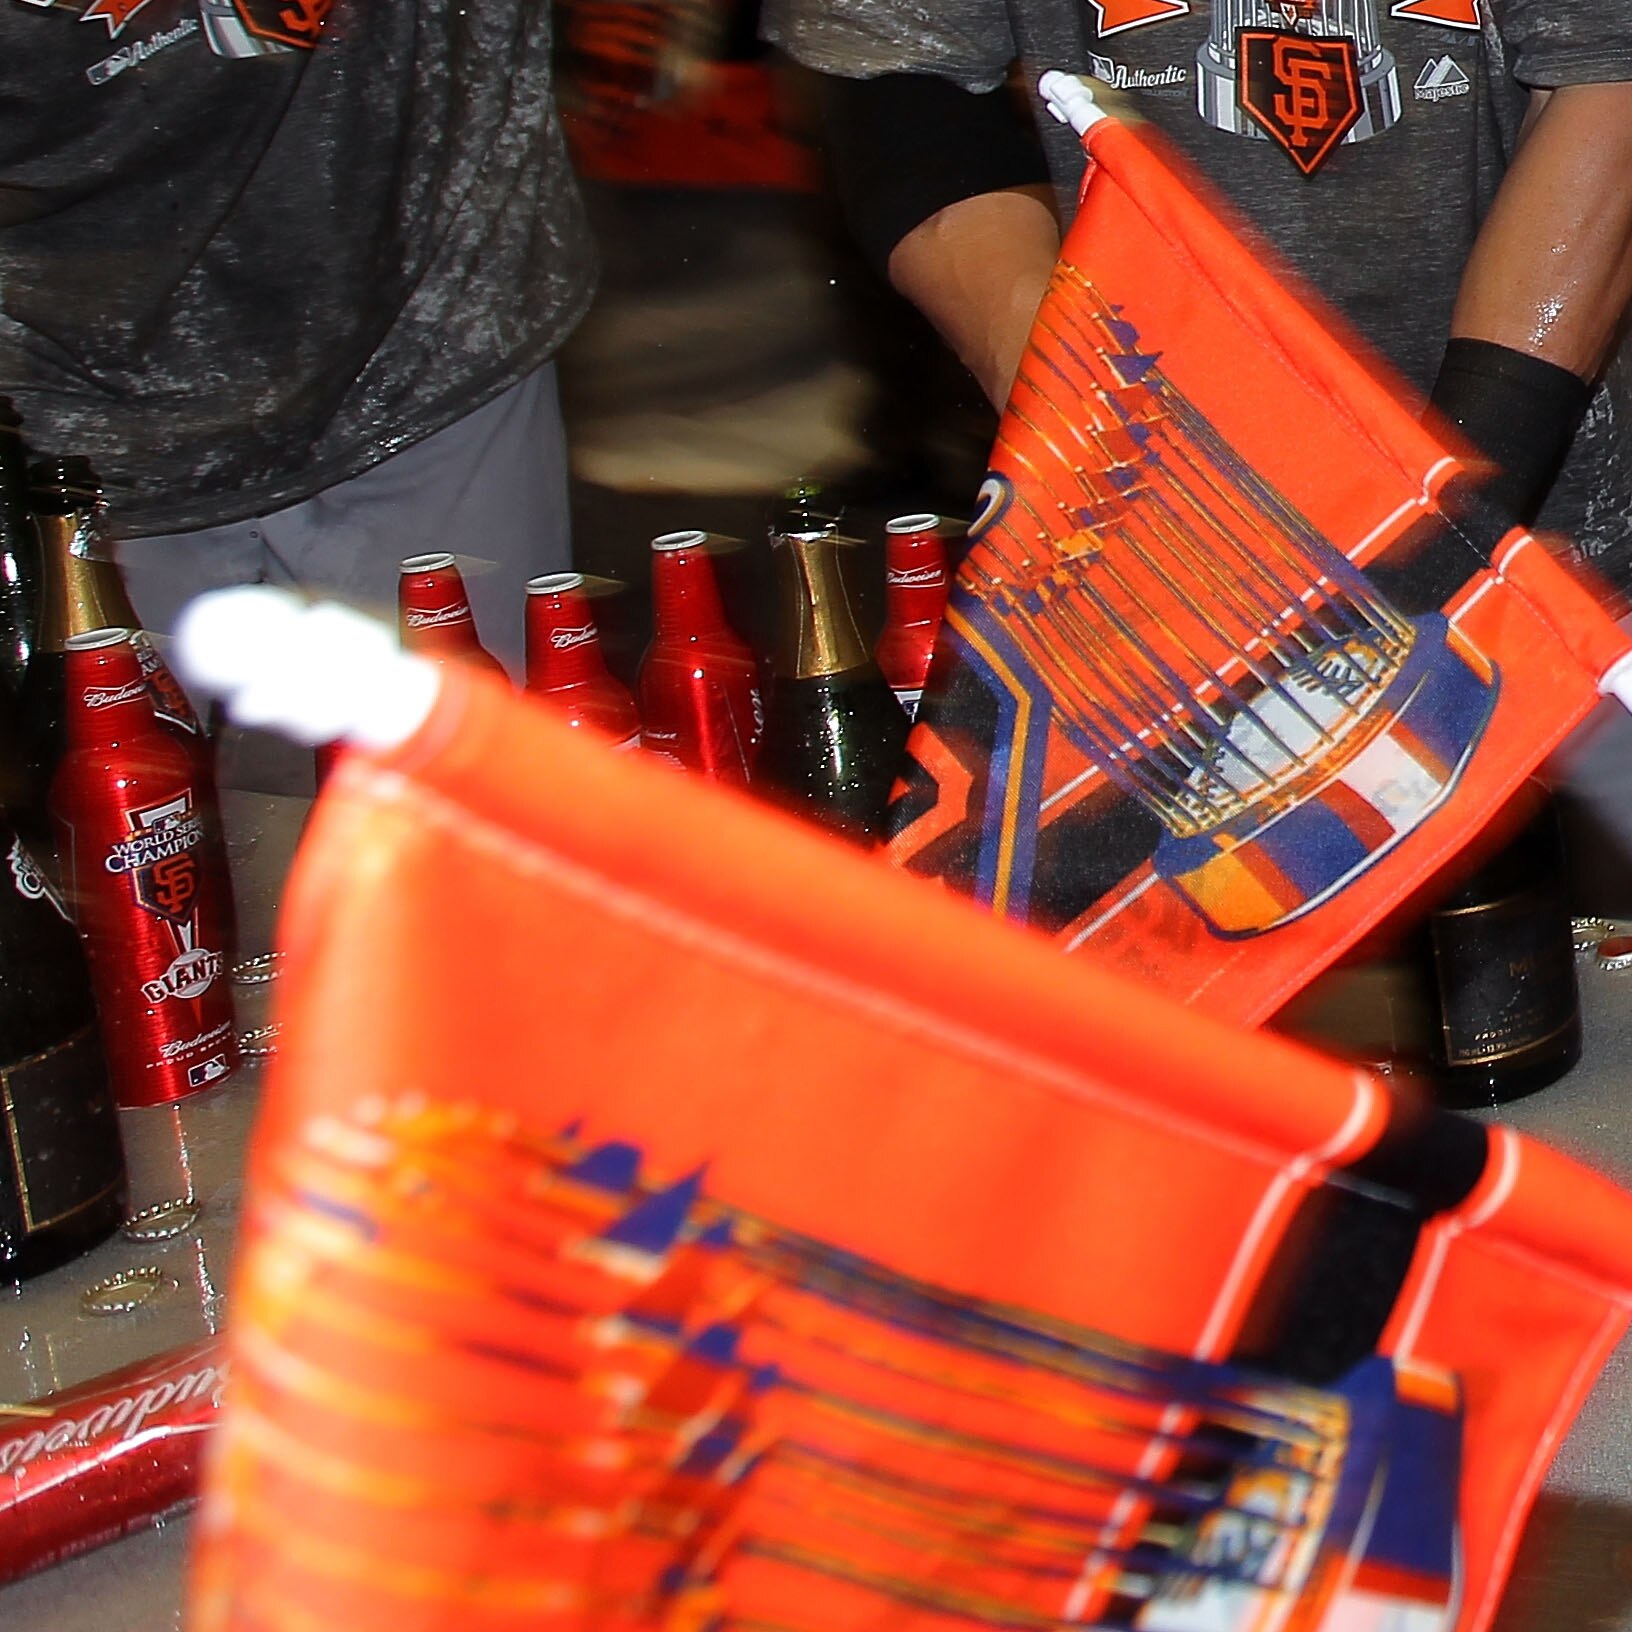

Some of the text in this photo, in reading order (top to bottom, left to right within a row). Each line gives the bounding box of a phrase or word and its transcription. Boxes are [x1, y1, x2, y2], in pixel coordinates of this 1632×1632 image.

[1111, 65, 1186, 89] Authentic
[105, 830, 205, 873] CHAMPION
[112, 831, 175, 858] WORLD
